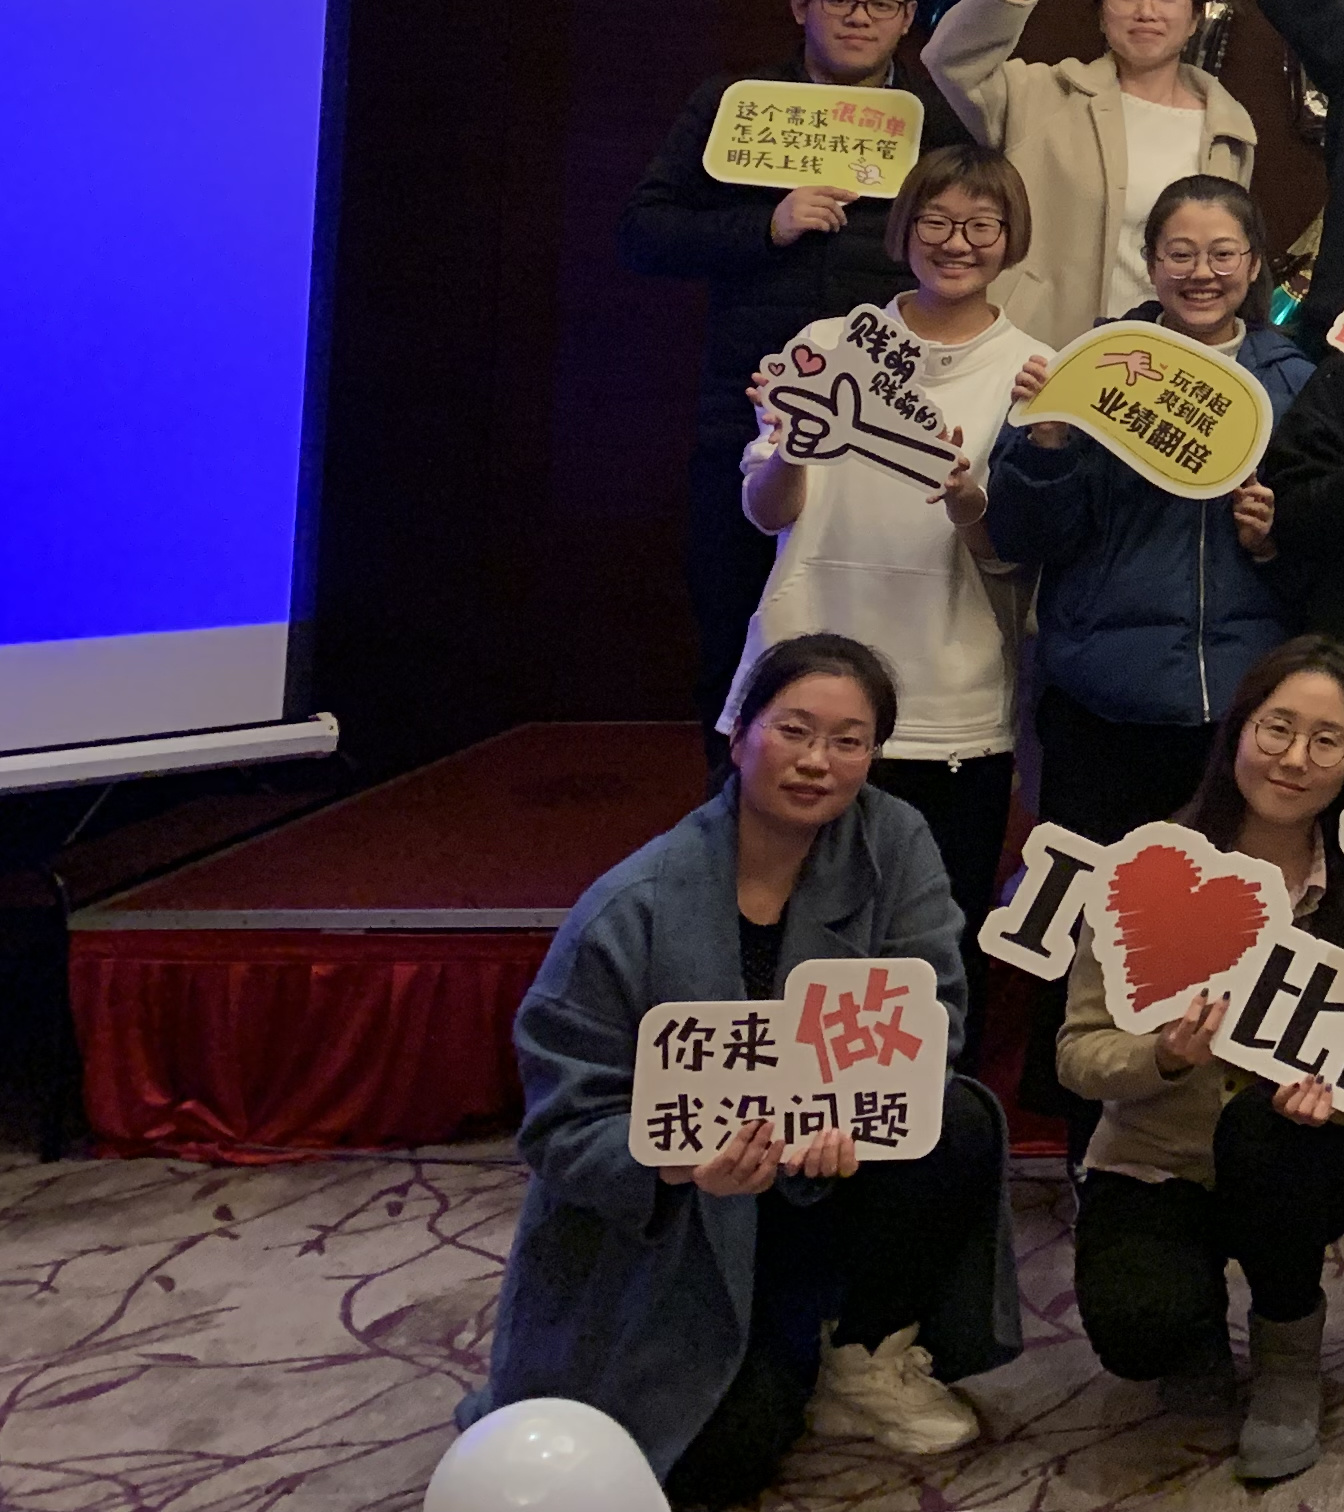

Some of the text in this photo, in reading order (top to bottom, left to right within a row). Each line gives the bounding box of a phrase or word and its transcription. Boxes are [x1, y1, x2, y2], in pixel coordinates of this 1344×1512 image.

[731, 123, 898, 160] 怎么实现我不管
[735, 100, 907, 138] 这个需求很简单
[727, 149, 824, 175] 明天上线
[1154, 388, 1218, 438] 爽到底
[1169, 368, 1233, 418] 玩得起
[1090, 386, 1212, 474] 业绩翻倍
[1000, 845, 1095, 958] I
[653, 968, 923, 1084] 你来做
[647, 1091, 909, 1152] 我没问题
